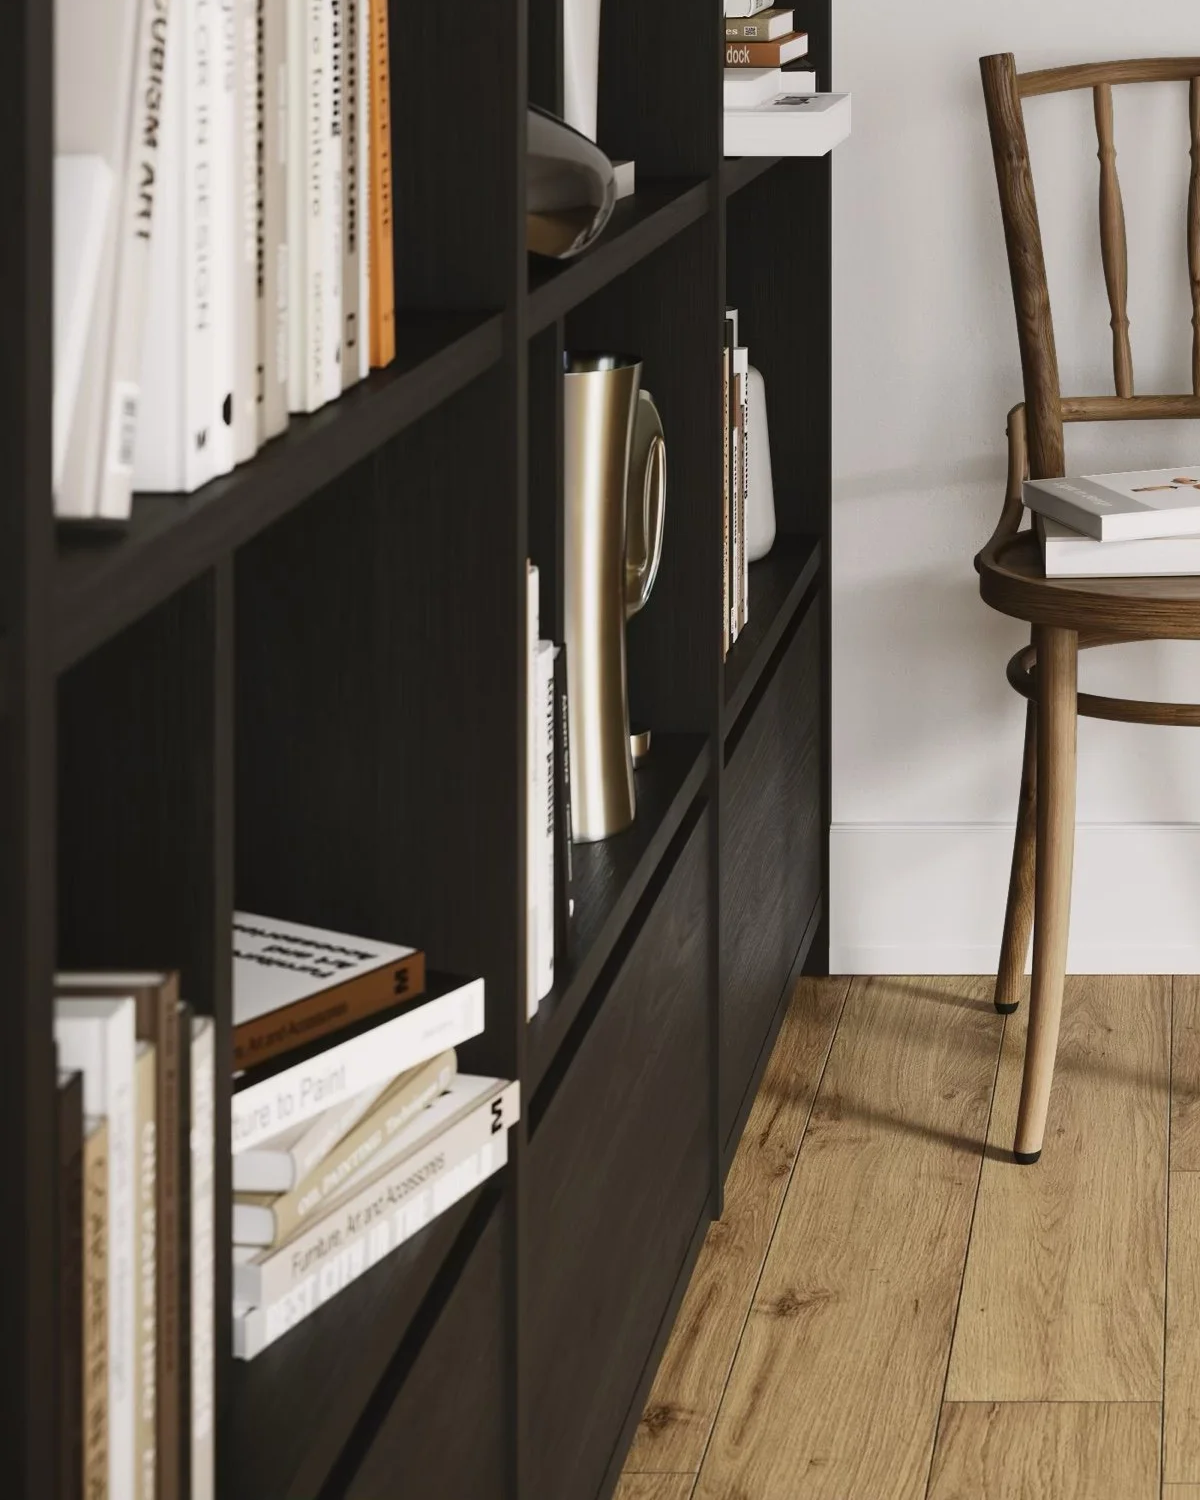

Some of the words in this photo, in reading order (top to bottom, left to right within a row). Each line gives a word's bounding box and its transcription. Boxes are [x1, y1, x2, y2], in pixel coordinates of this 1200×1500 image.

[726, 45, 751, 64] dock
[132, 158, 157, 244] ART
[276, 1091, 295, 1121] to
[299, 1064, 346, 1109] Paint
